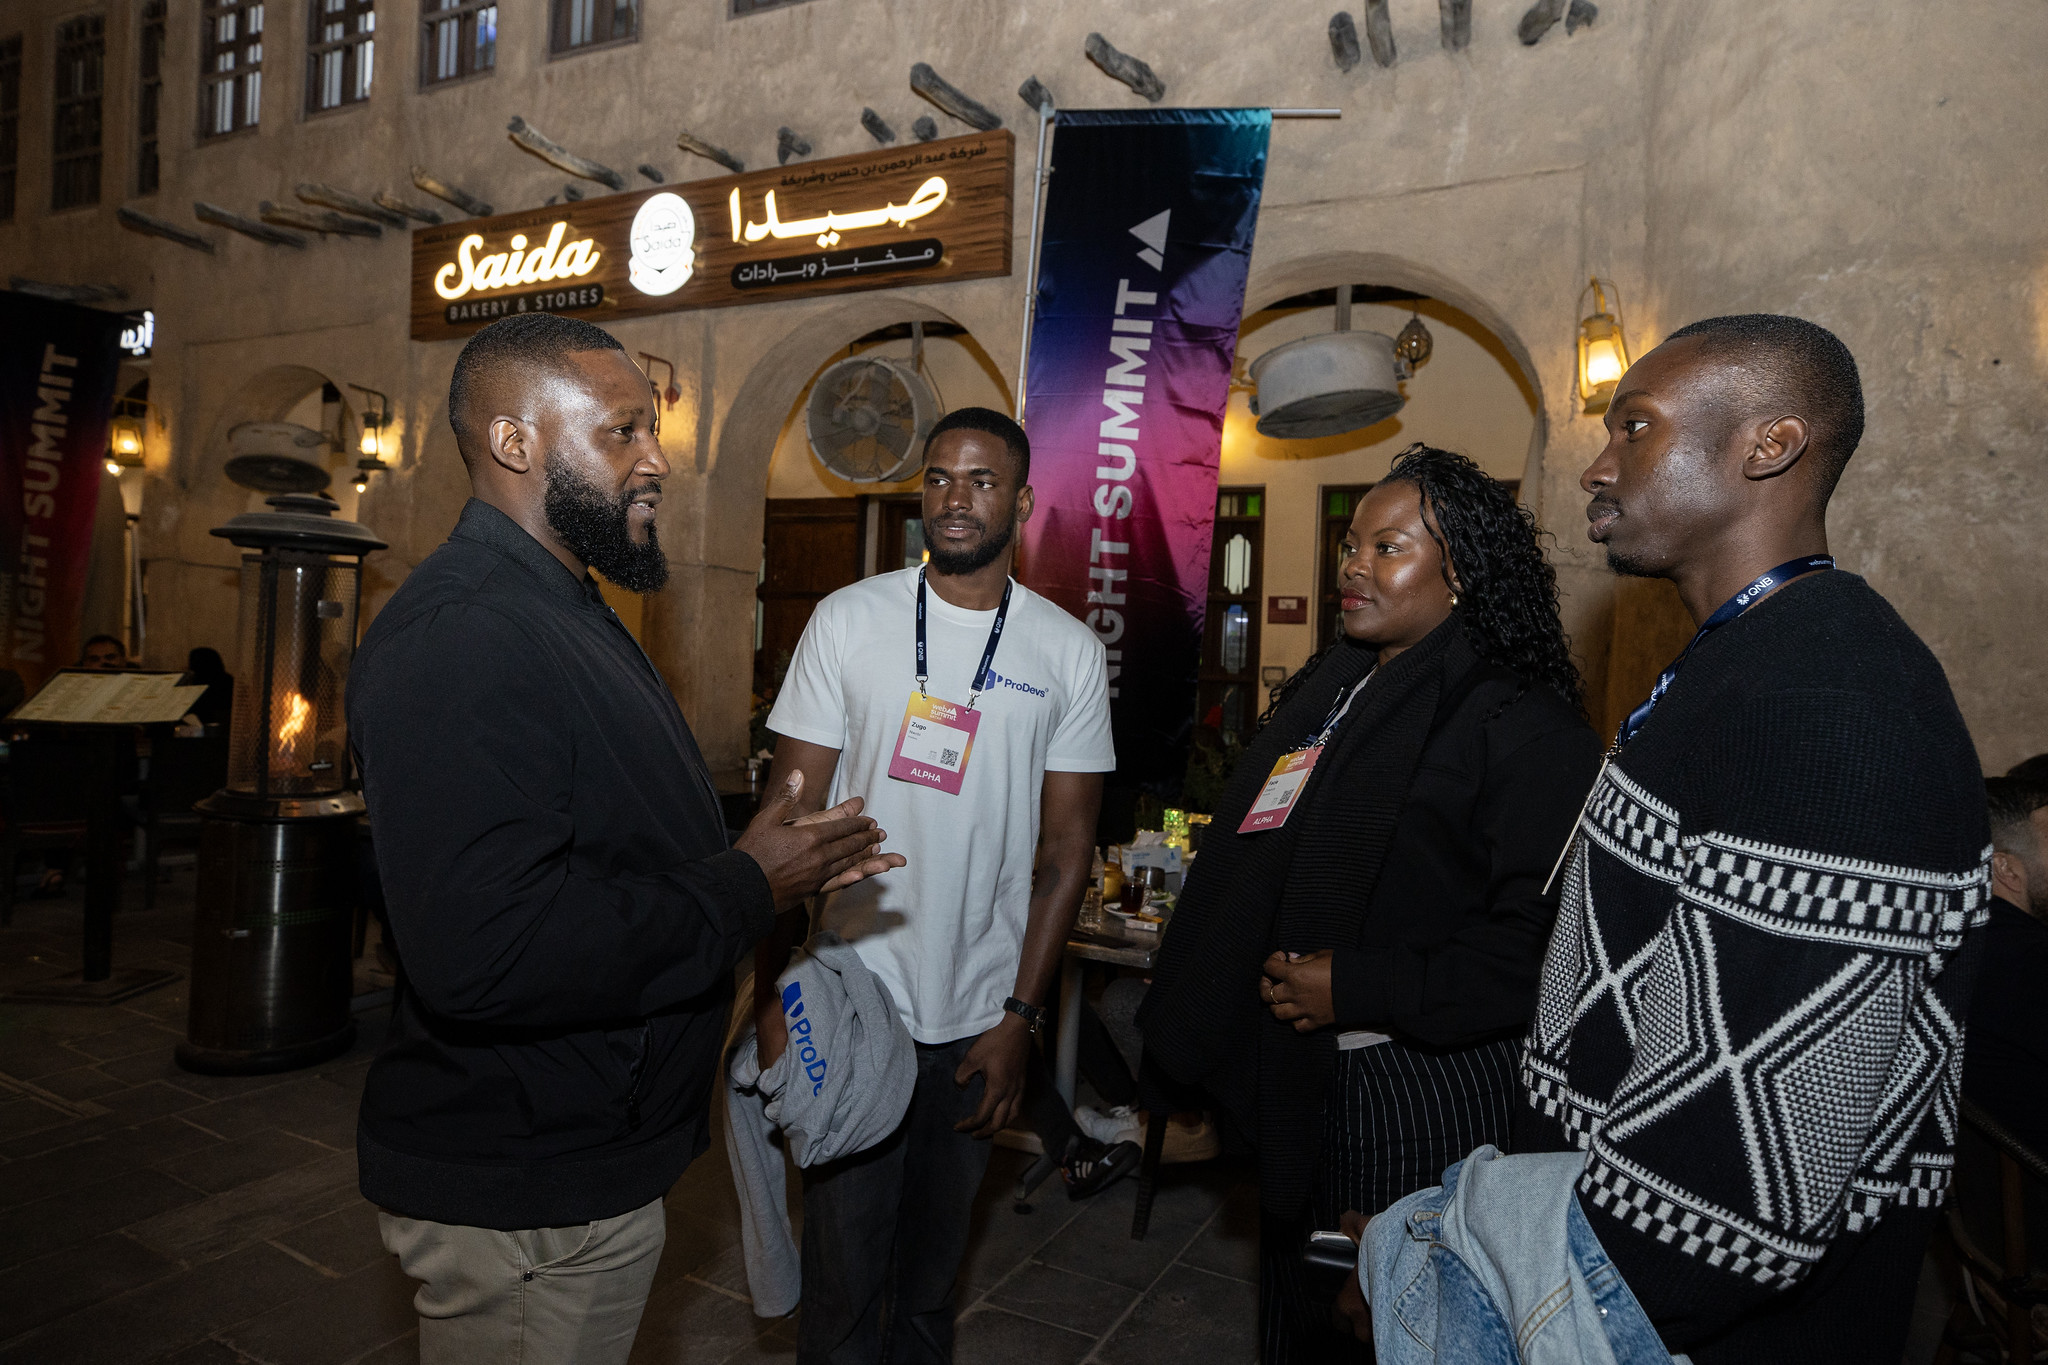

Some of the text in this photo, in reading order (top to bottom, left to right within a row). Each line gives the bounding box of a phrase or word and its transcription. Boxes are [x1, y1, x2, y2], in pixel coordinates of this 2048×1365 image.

[729, 176, 948, 248] صيدا
[434, 221, 600, 299] Saida
[738, 247, 935, 282] مخبز وبرادات
[450, 288, 600, 321] BAKERY & STORES
[1093, 279, 1157, 520] SUMMIT
[13, 343, 78, 663] NIGHT SUMMIT
[1747, 576, 1774, 596] QNB
[930, 708, 957, 722] summit
[932, 703, 948, 713] web
[911, 721, 927, 731] Zugo
[910, 767, 941, 783] ALPHA
[1252, 815, 1274, 826] ALPHA
